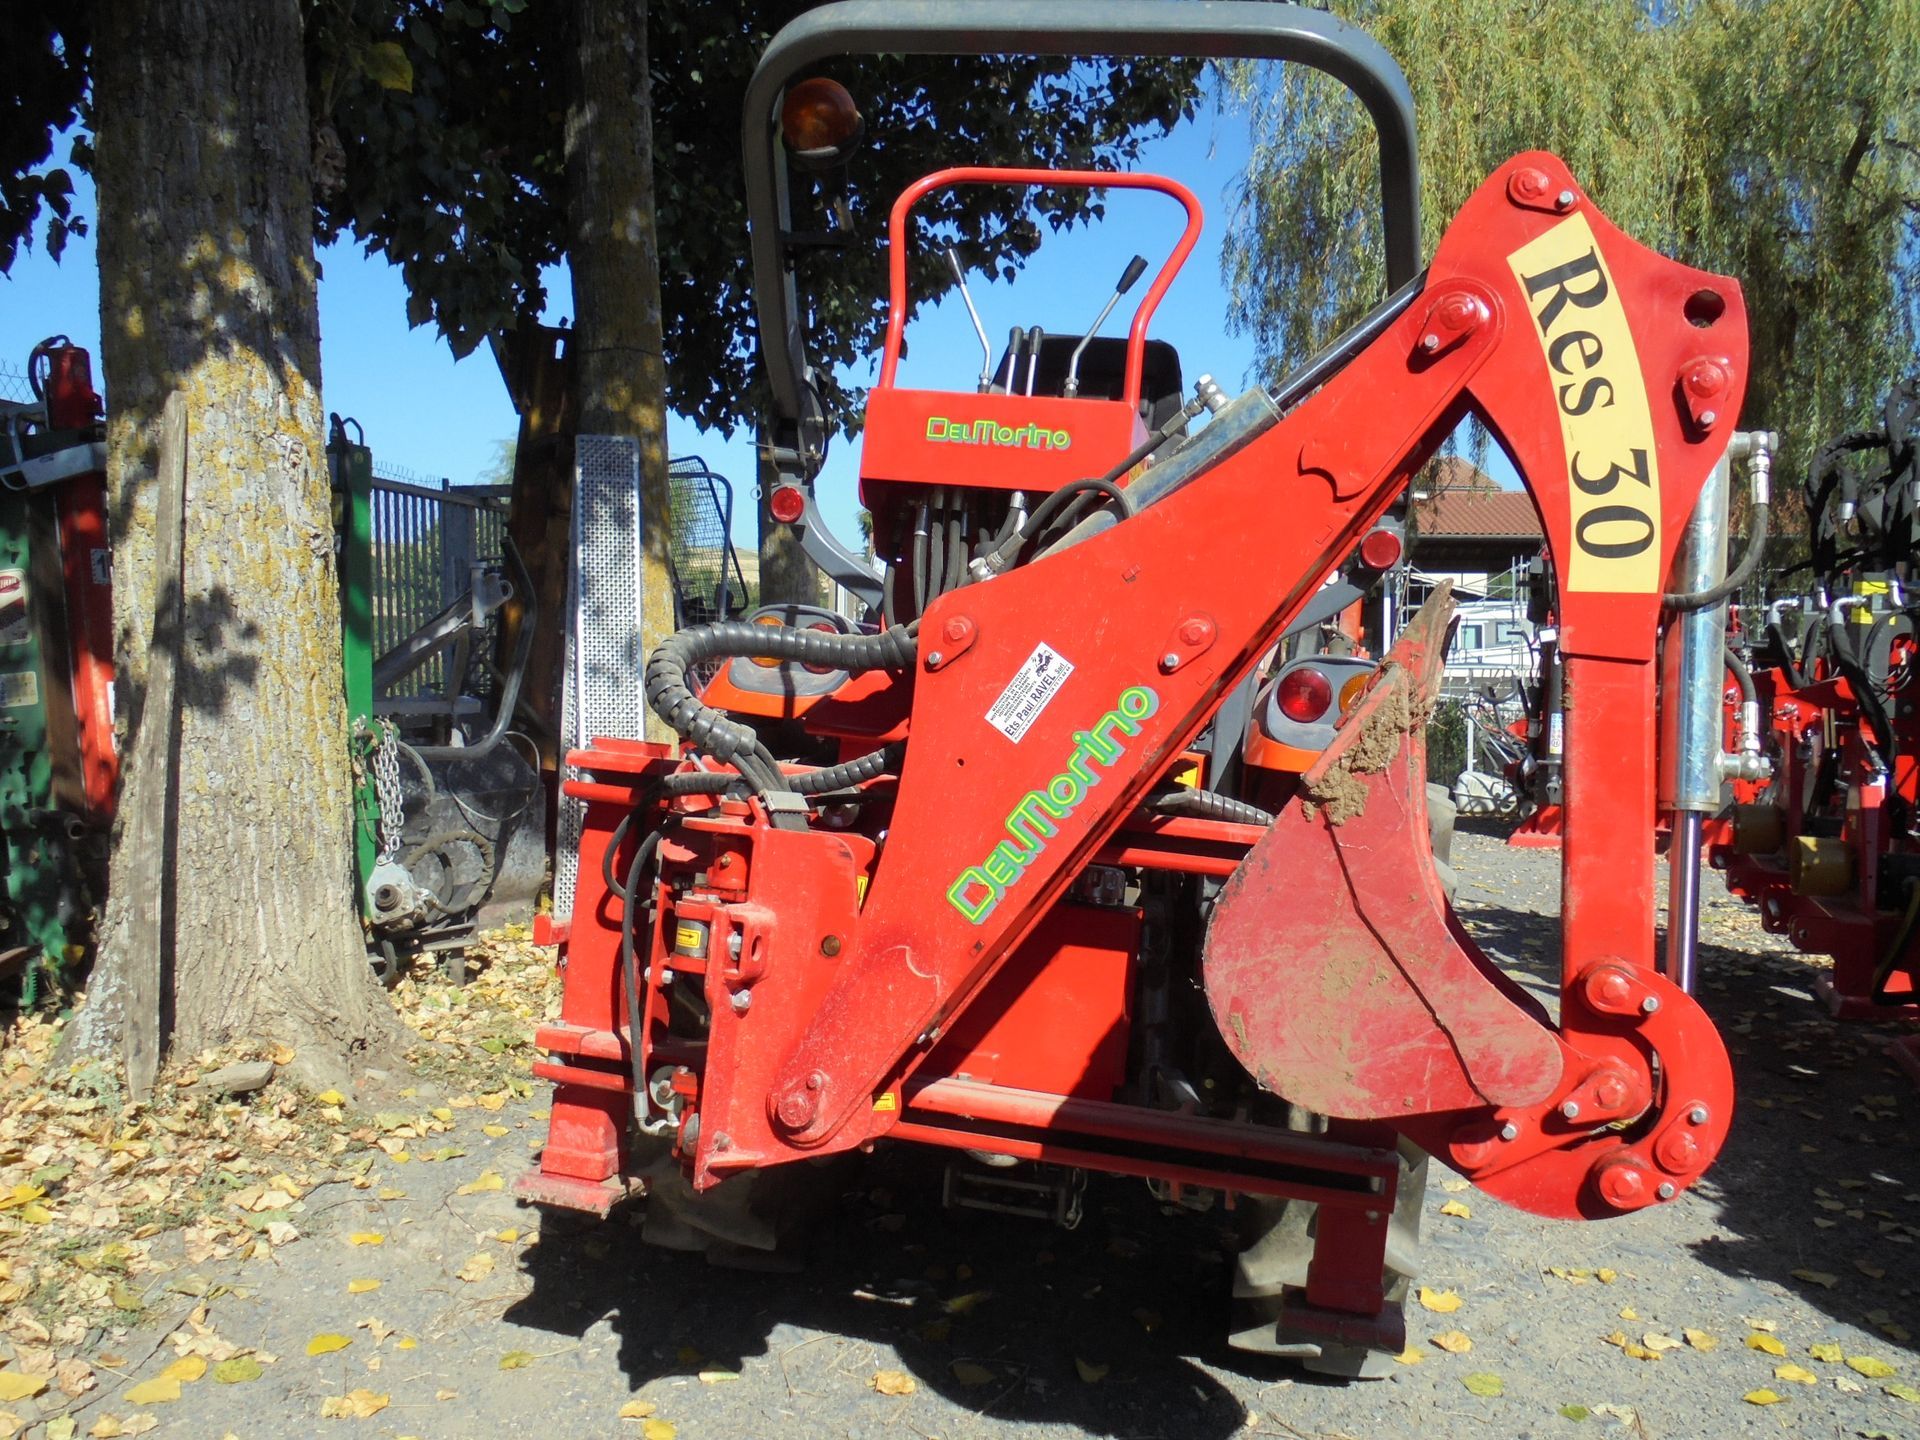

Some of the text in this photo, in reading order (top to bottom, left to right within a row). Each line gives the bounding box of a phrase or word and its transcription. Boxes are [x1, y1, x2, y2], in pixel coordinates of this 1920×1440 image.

[1520, 245, 1655, 559] Res 30
[1004, 721, 1020, 736] Ets
[1015, 701, 1033, 722] Paul
[1030, 673, 1056, 702] RAVEL
